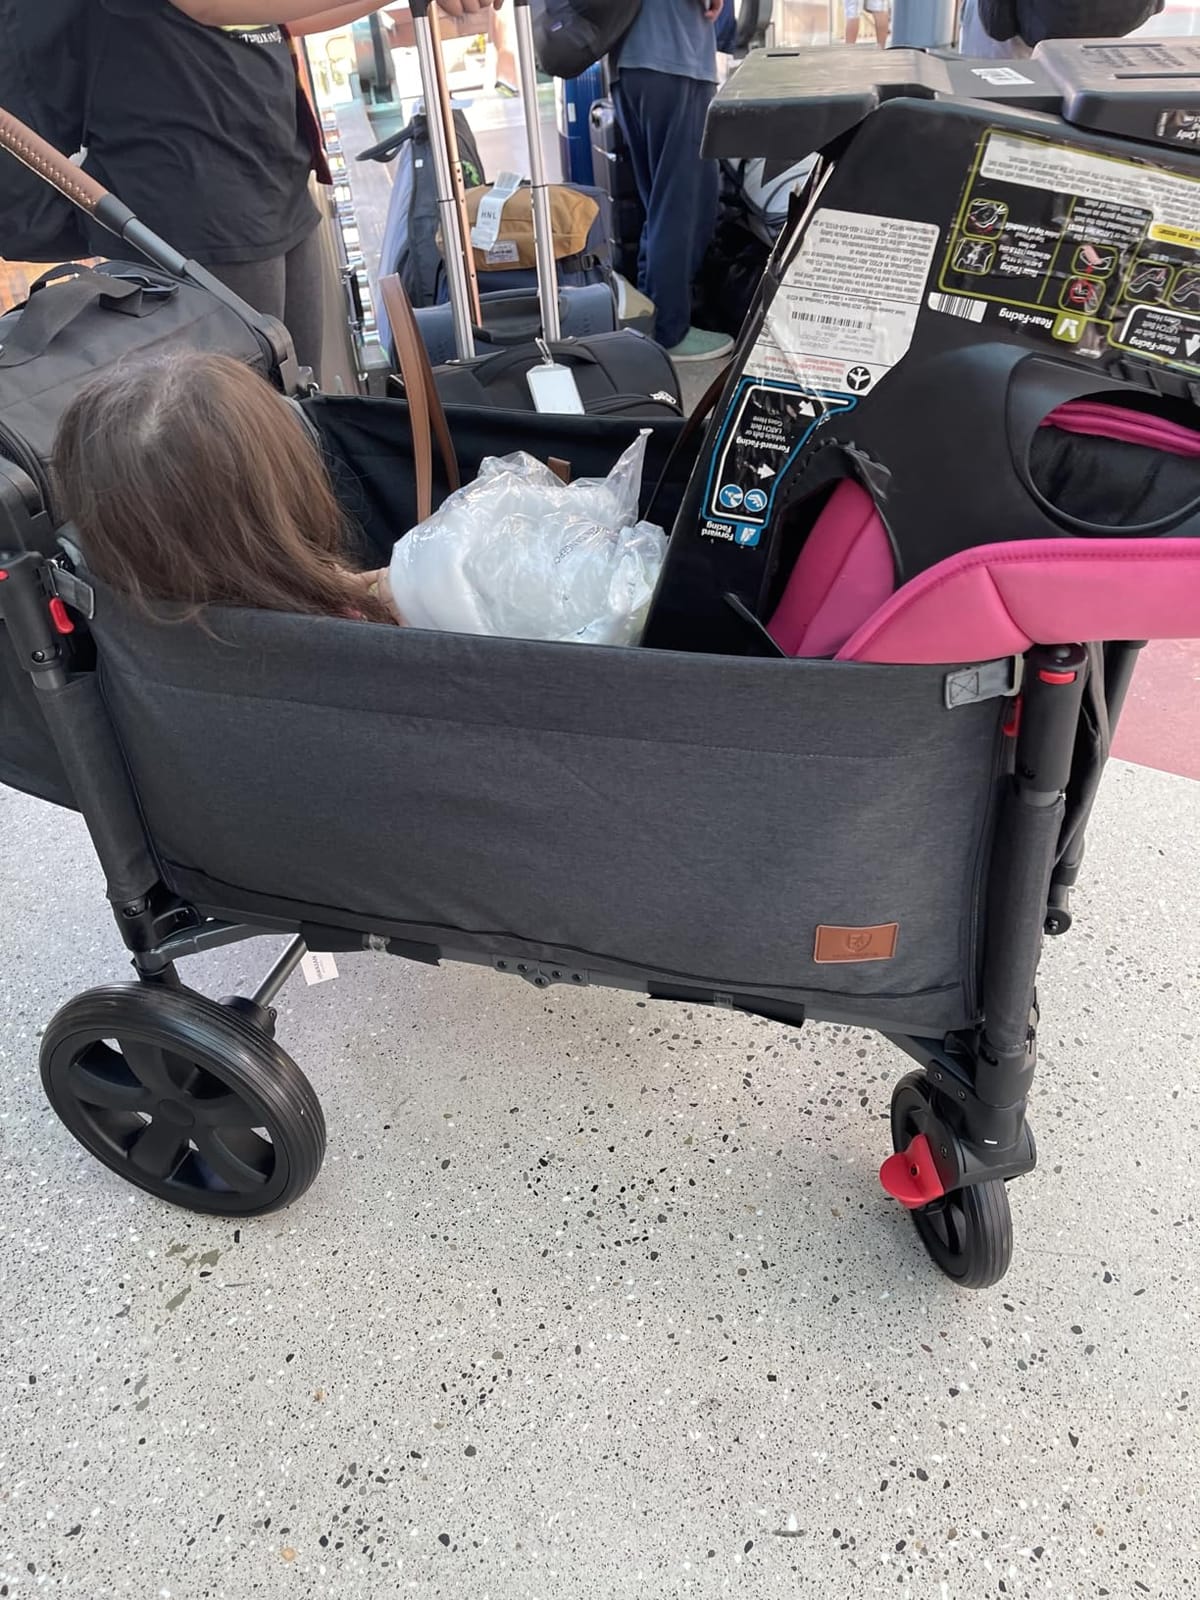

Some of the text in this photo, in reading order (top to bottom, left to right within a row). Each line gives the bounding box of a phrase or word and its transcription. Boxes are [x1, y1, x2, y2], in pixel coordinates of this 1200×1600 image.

[1176, 129, 1196, 140] Only
[481, 211, 497, 220] HNL
[997, 306, 1054, 329] Rear-Facing
[1128, 335, 1177, 355] Rear-Facing
[749, 422, 783, 434] LATCH Belt
[751, 430, 764, 439] Belt
[763, 432, 786, 442] Vehicle
[734, 435, 791, 453] Forward-Facing
[705, 520, 732, 533] Facing
[700, 527, 734, 541] Forward
